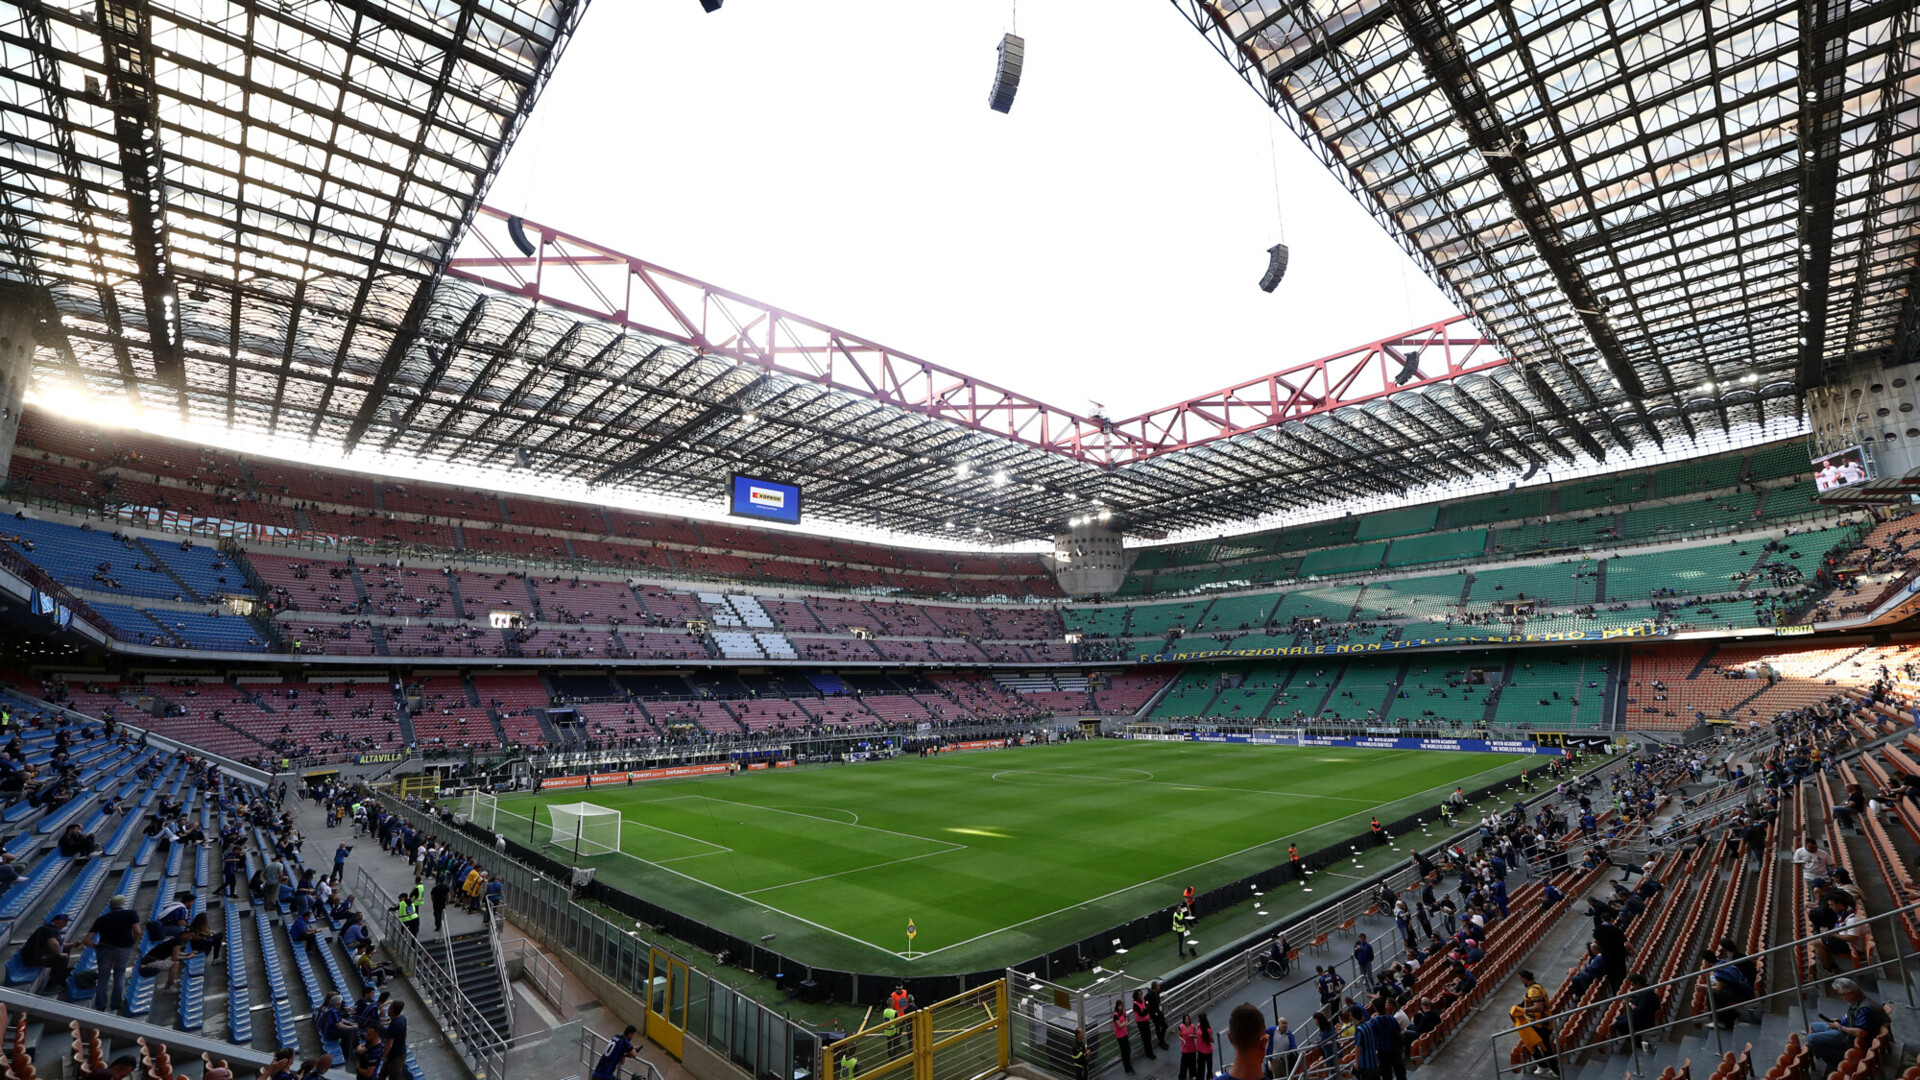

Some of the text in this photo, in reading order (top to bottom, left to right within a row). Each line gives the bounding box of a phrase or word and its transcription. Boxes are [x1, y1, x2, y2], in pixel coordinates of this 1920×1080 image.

[1140, 654, 1168, 663] F.C.
[1172, 645, 1326, 661] INTERNAZIONALE
[1335, 643, 1381, 653] NON
[1391, 640, 1411, 648] TI
[360, 753, 402, 764] ALTAVILLA
